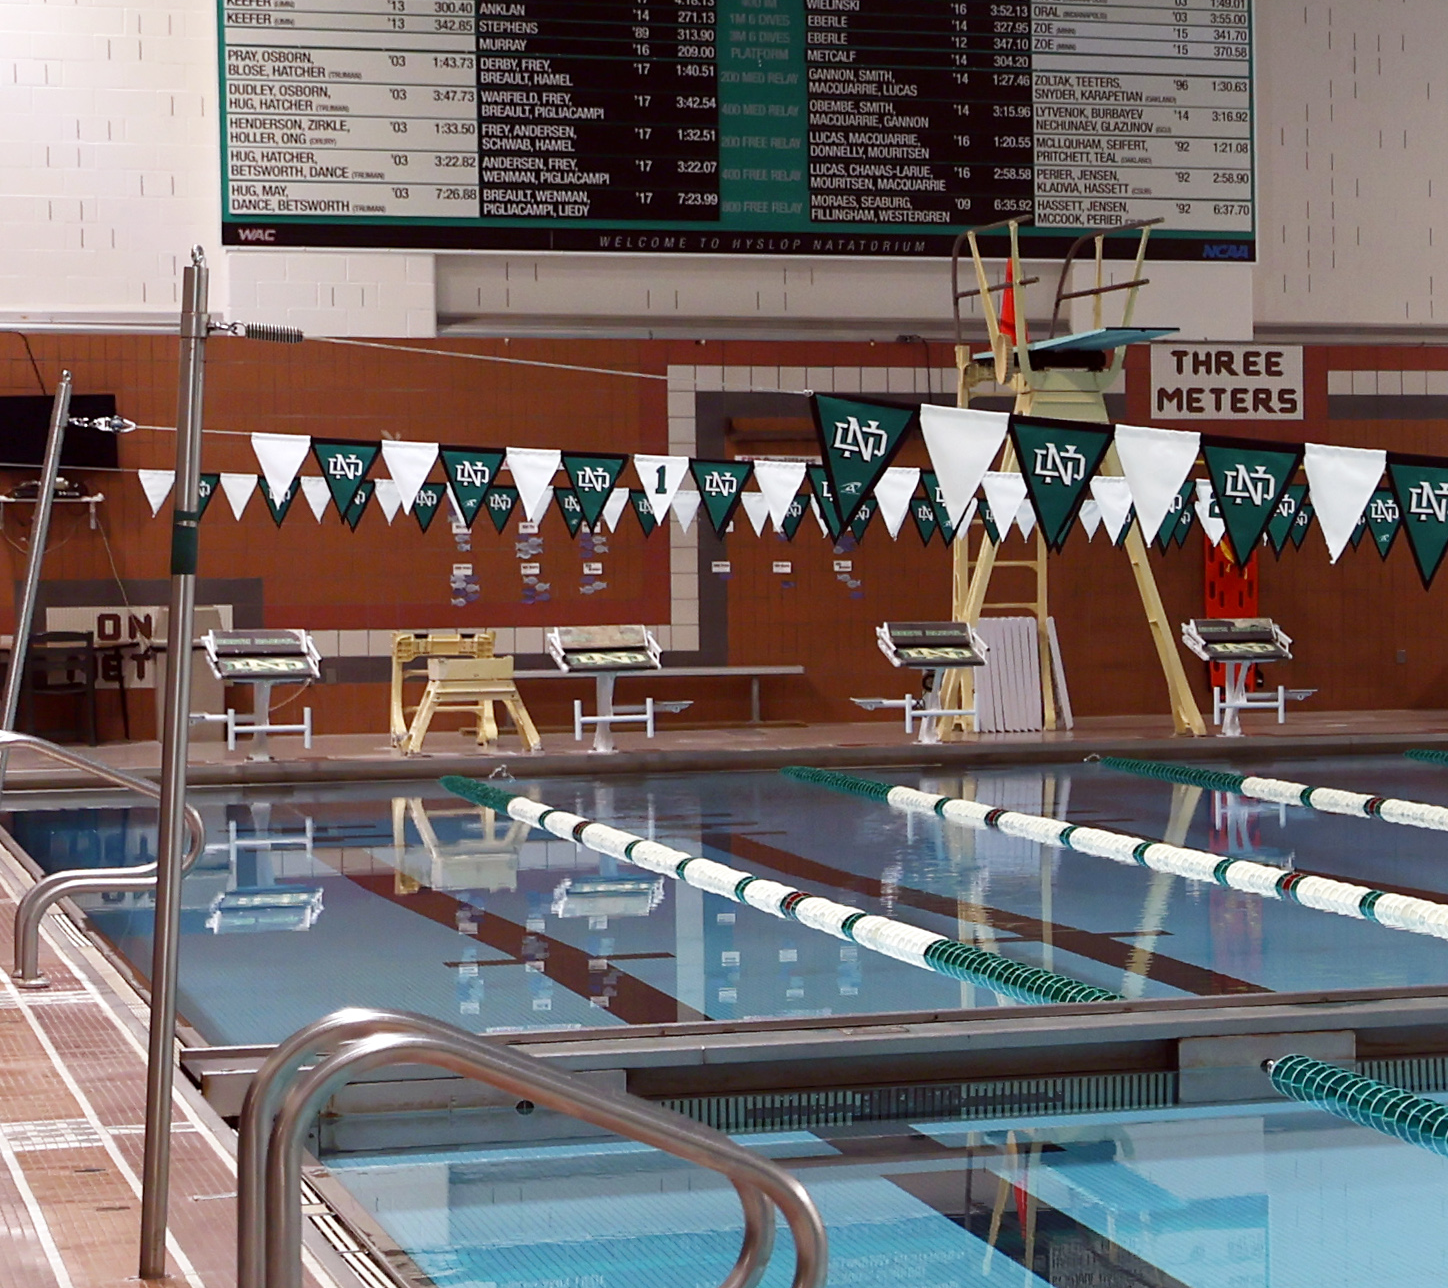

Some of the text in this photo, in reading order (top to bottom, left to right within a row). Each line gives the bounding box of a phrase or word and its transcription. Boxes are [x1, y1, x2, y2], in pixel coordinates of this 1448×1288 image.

[479, 21, 538, 34] STEPHENS
[310, 167, 349, 178] DANCE
[880, 211, 950, 223] WESTERGREN
[238, 229, 276, 241] WAC
[600, 236, 929, 252] WELCOME TO HYSLOP NATATORIUM
[1203, 244, 1248, 258] NCAA
[1170, 350, 1284, 376] THREE
[1157, 387, 1298, 413] METERS
